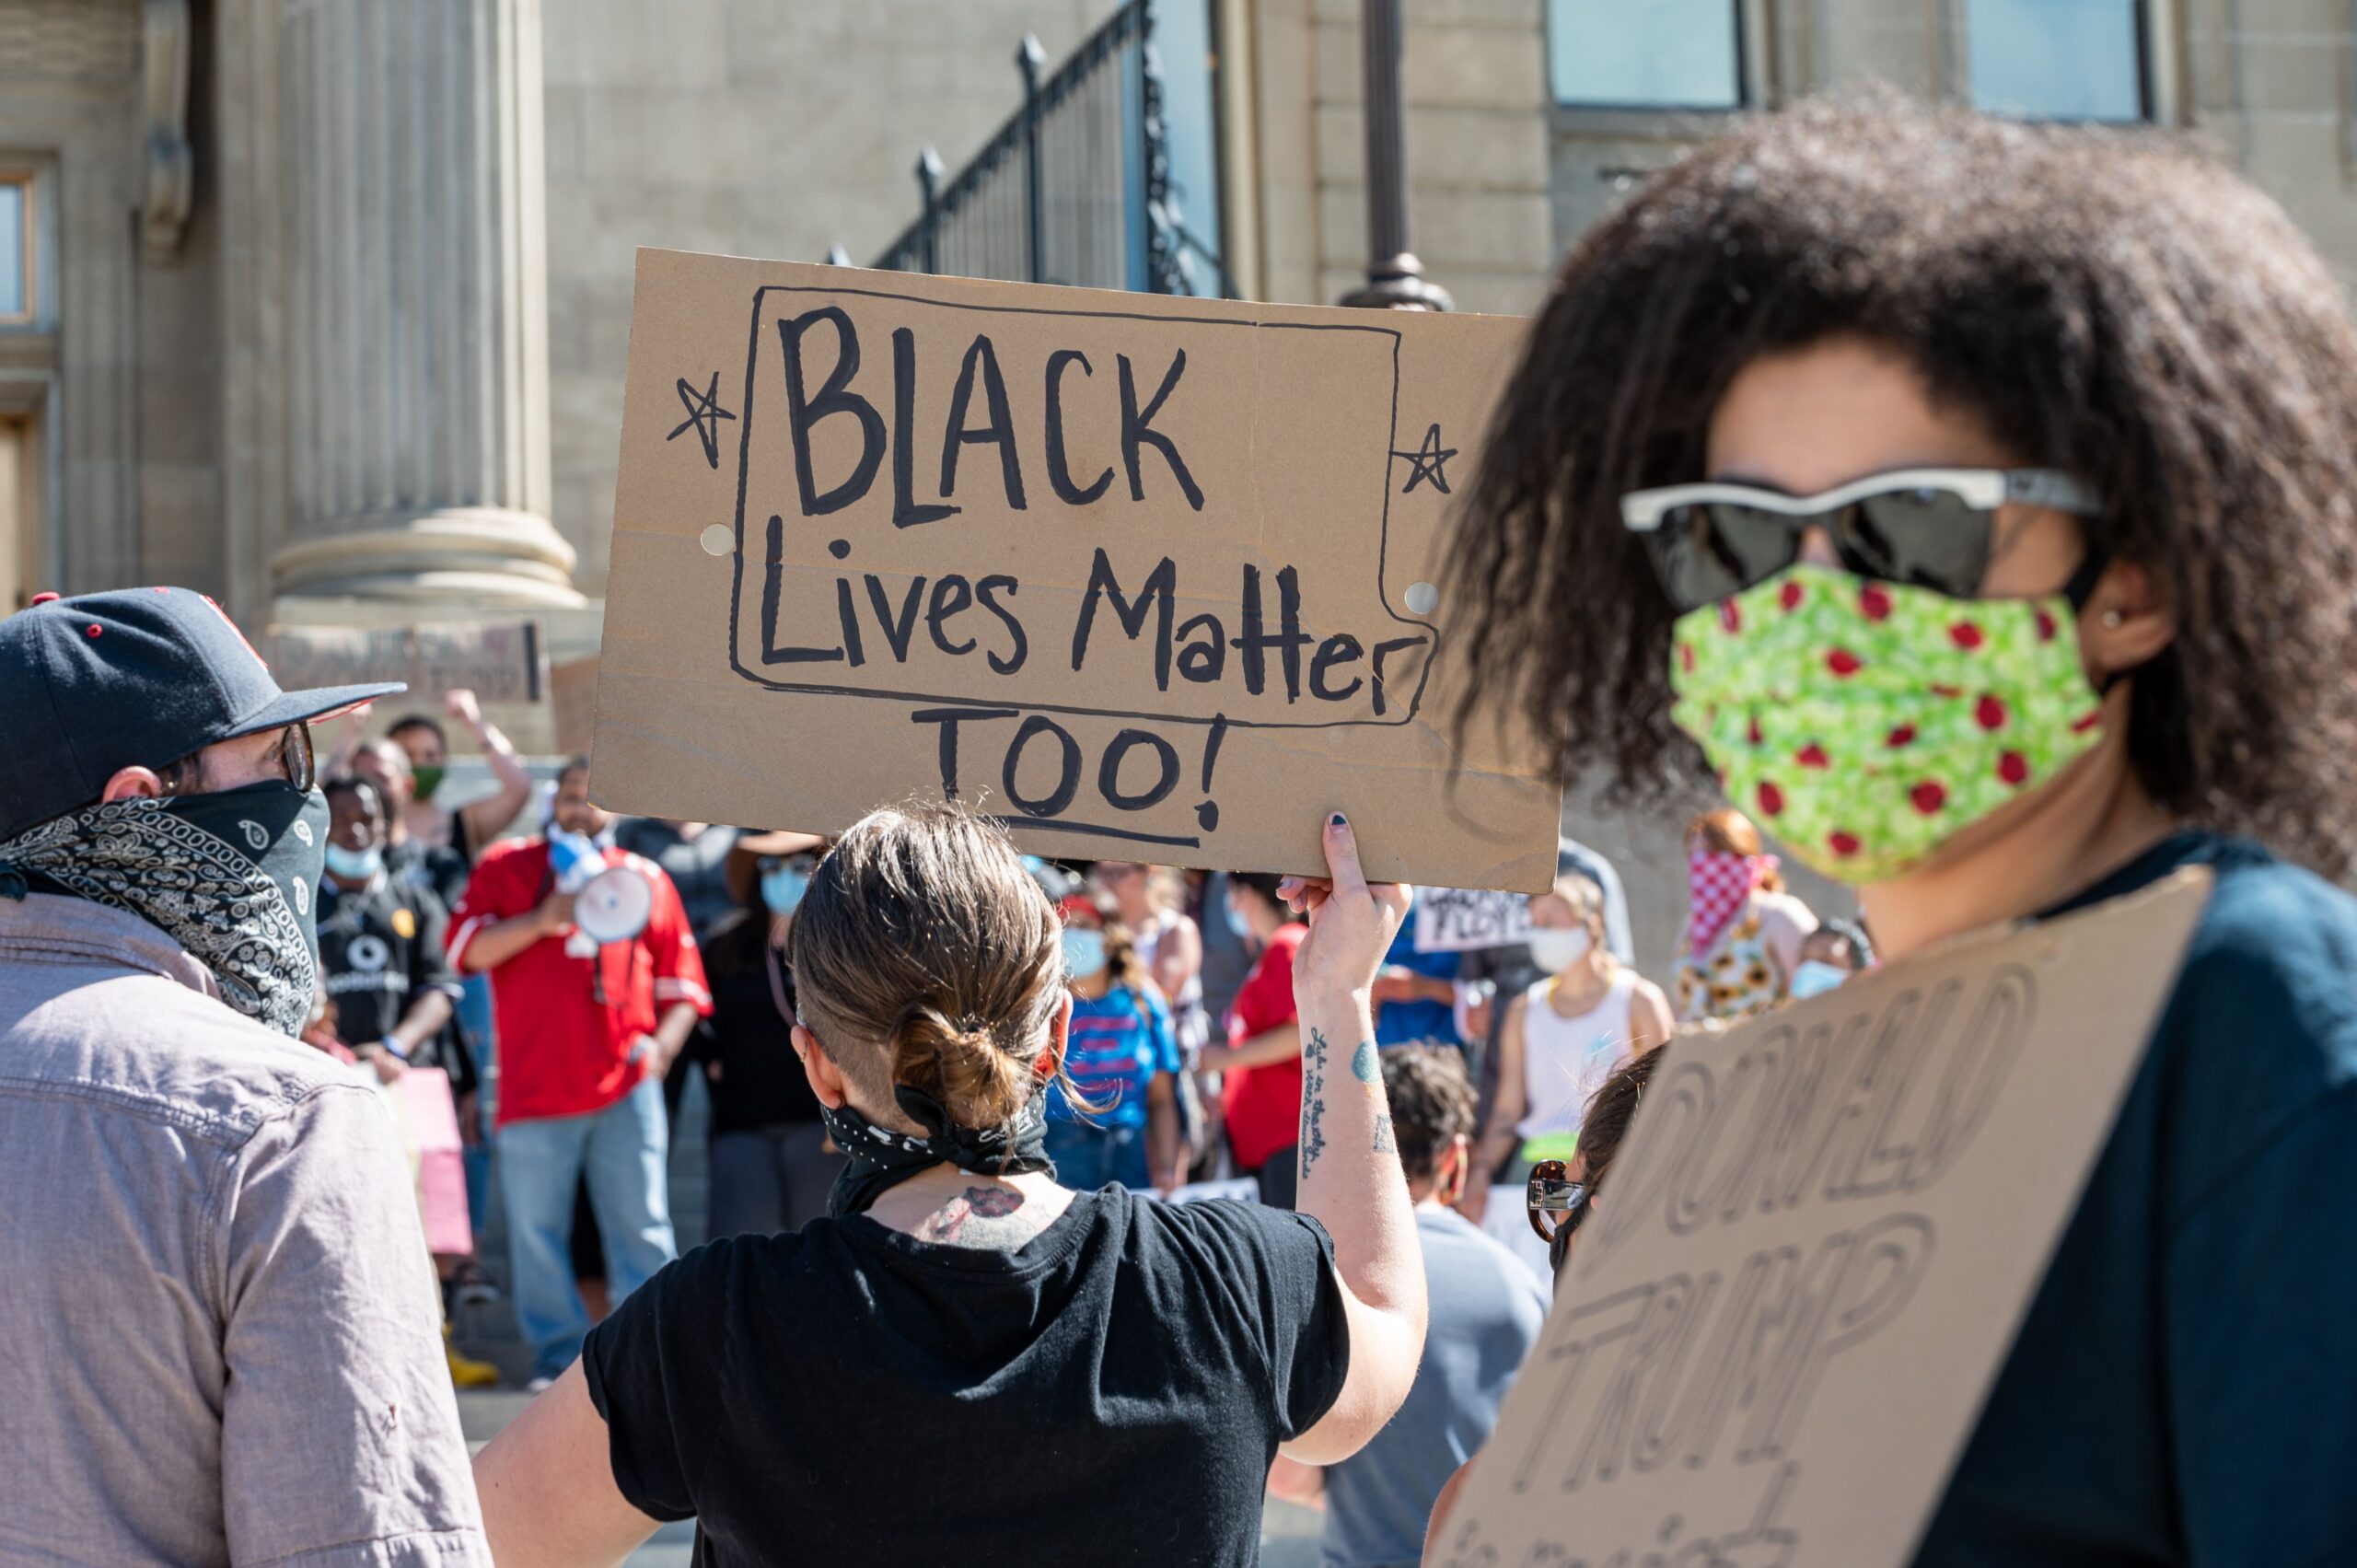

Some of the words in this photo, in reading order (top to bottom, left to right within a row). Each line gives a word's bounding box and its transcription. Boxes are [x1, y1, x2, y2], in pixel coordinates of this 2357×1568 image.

[777, 306, 1204, 528] BLACK
[761, 516, 1029, 675] Lives
[1072, 548, 1427, 716] Matter
[911, 708, 1226, 832] TOO!
[1577, 963, 2038, 1280] DONALD
[1512, 1211, 1938, 1494] TRUMP
